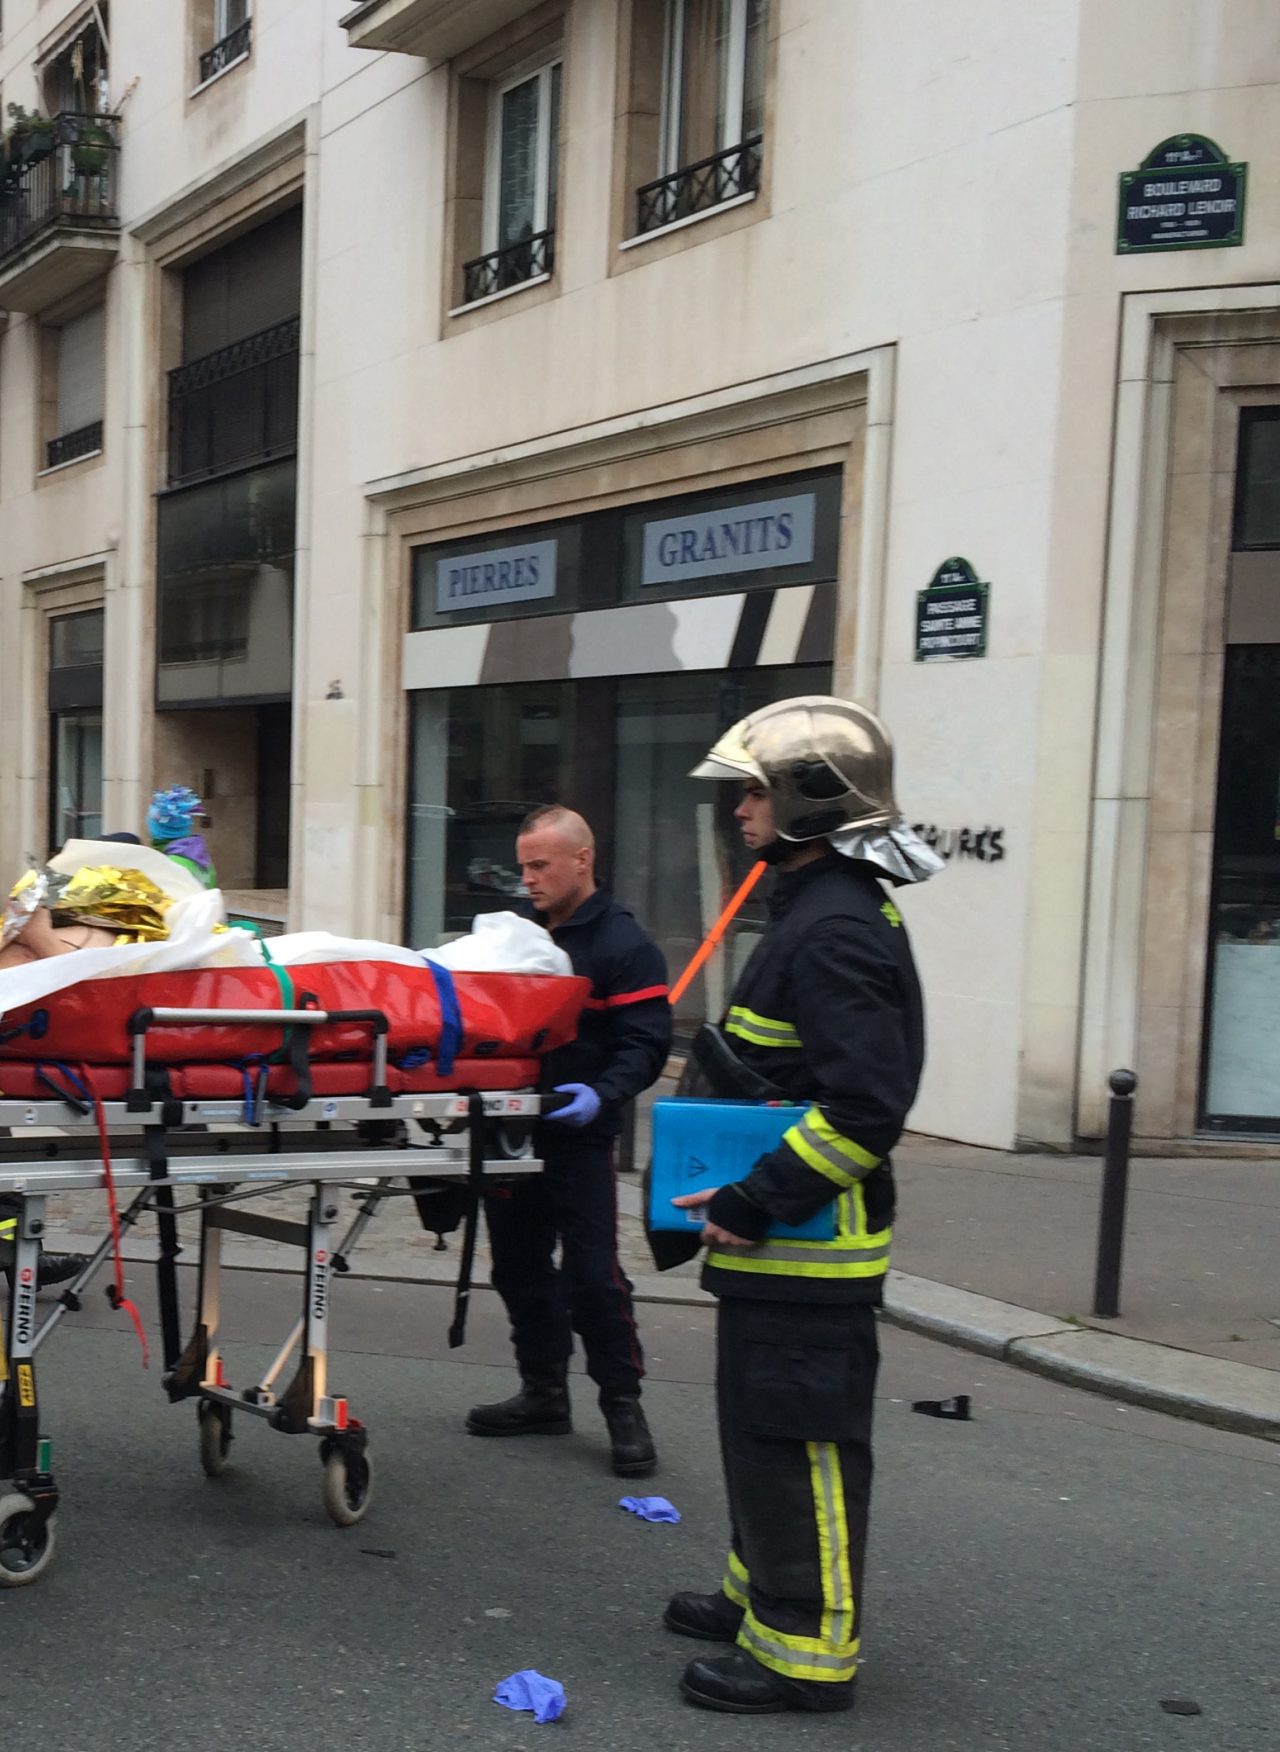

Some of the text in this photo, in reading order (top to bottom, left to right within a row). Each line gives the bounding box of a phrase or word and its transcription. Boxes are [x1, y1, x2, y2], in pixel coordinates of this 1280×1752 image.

[1126, 198, 1236, 220] RICHARD LENOIR
[1143, 178, 1222, 197] BOULEVARD
[658, 512, 794, 567] GRANITS
[447, 555, 540, 598] PIERRES
[17, 1283, 36, 1345] FERNO
